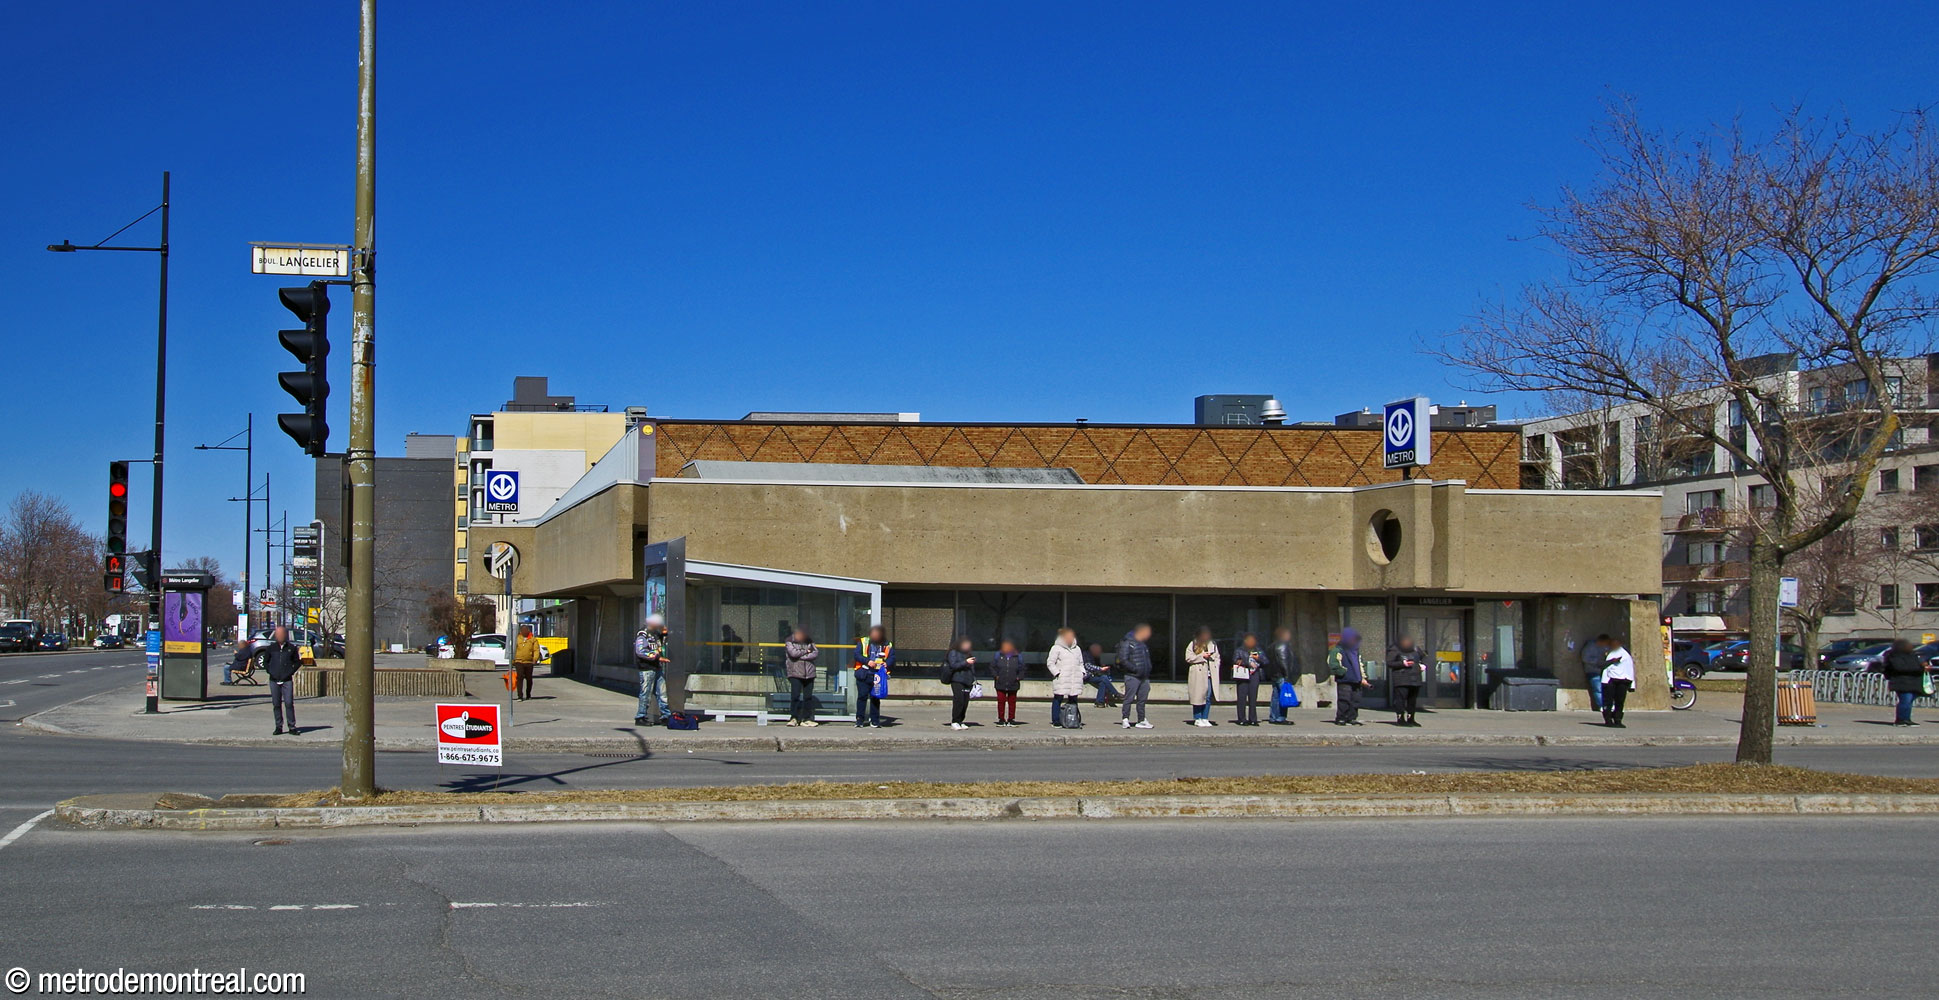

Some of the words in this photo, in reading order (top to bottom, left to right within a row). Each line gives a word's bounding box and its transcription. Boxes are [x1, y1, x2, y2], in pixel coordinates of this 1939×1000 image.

[258, 257, 278, 265] BOUL.
[279, 256, 340, 268] LANGELIER
[1387, 449, 1415, 465] METRO
[488, 502, 517, 511] METRO
[443, 723, 465, 731] PEINTRES
[465, 723, 493, 732] ÉTUDIANTS
[440, 752, 500, 763] 1-866-675-9675
